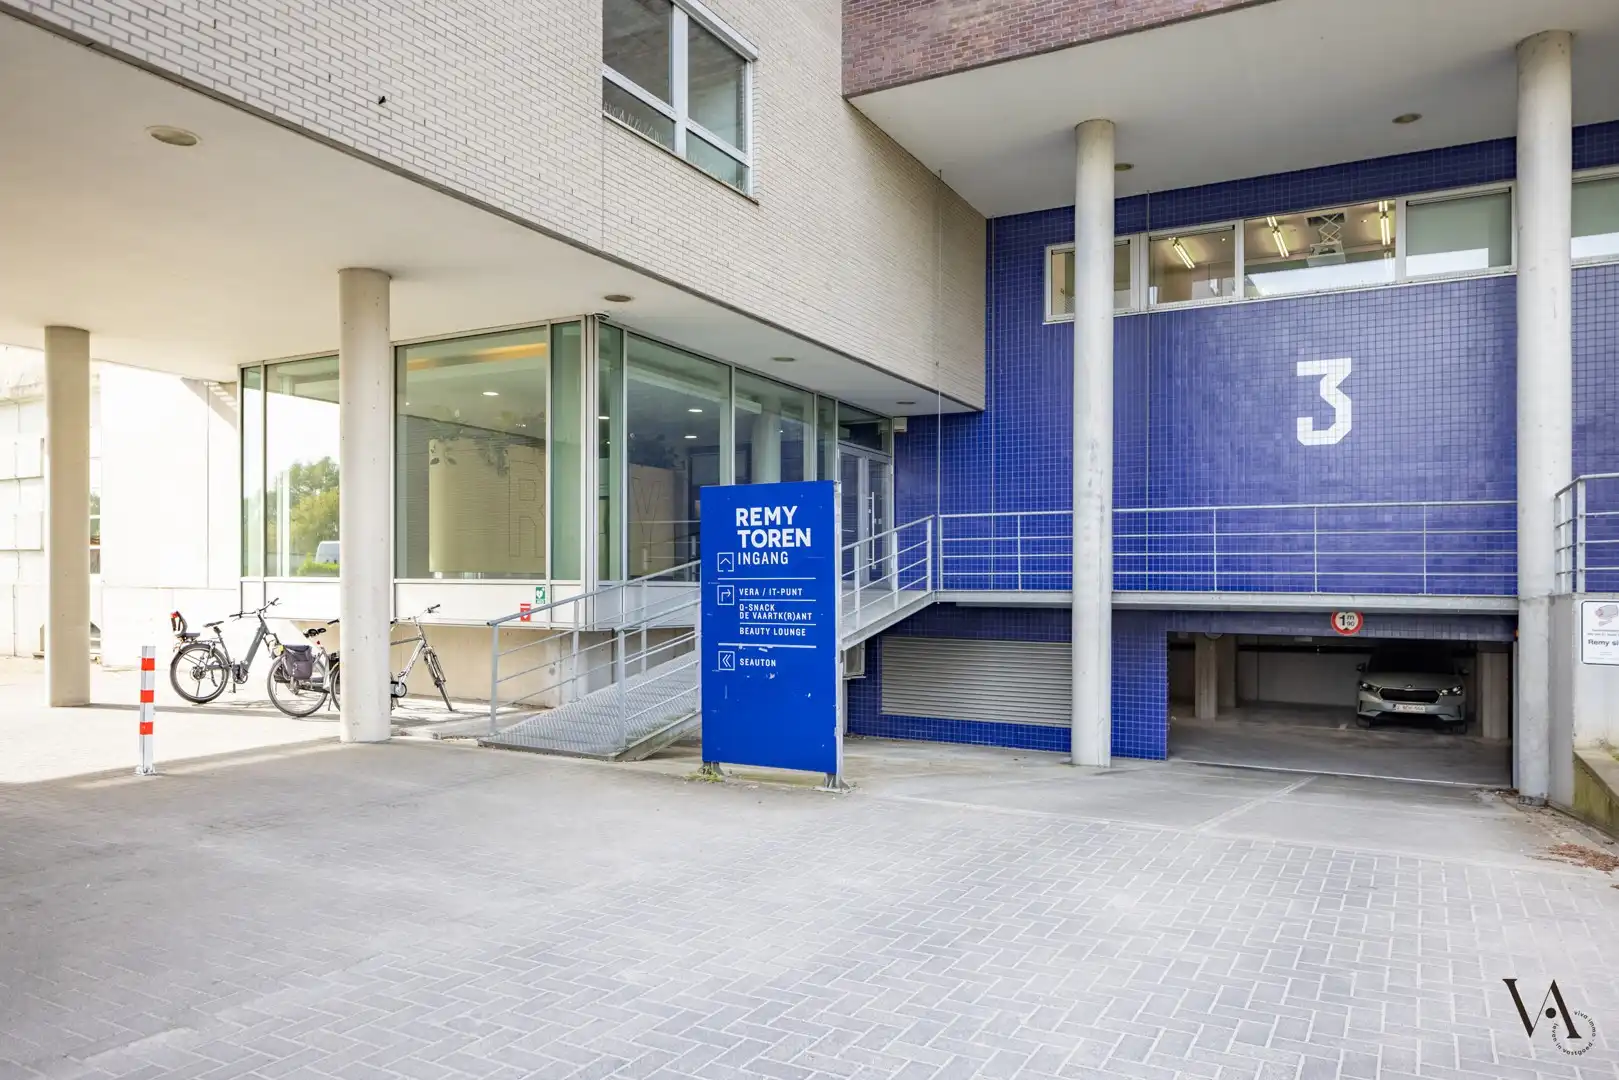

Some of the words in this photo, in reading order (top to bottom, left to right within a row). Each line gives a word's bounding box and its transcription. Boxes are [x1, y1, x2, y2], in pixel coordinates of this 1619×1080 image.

[1297, 358, 1351, 446] 3
[736, 505, 798, 526] REMY
[737, 528, 811, 548] TOREN
[738, 551, 789, 565] INGANG
[739, 588, 759, 596] VERA
[769, 588, 803, 596] IT-PUNT
[739, 604, 775, 612] Q-SNACK
[752, 612, 812, 621] VAARTK(R)ANT
[739, 627, 770, 635] BEAUTY
[773, 628, 806, 636] LOUNGE
[1588, 639, 1610, 647] Remy
[739, 658, 776, 667] SEAUTON
